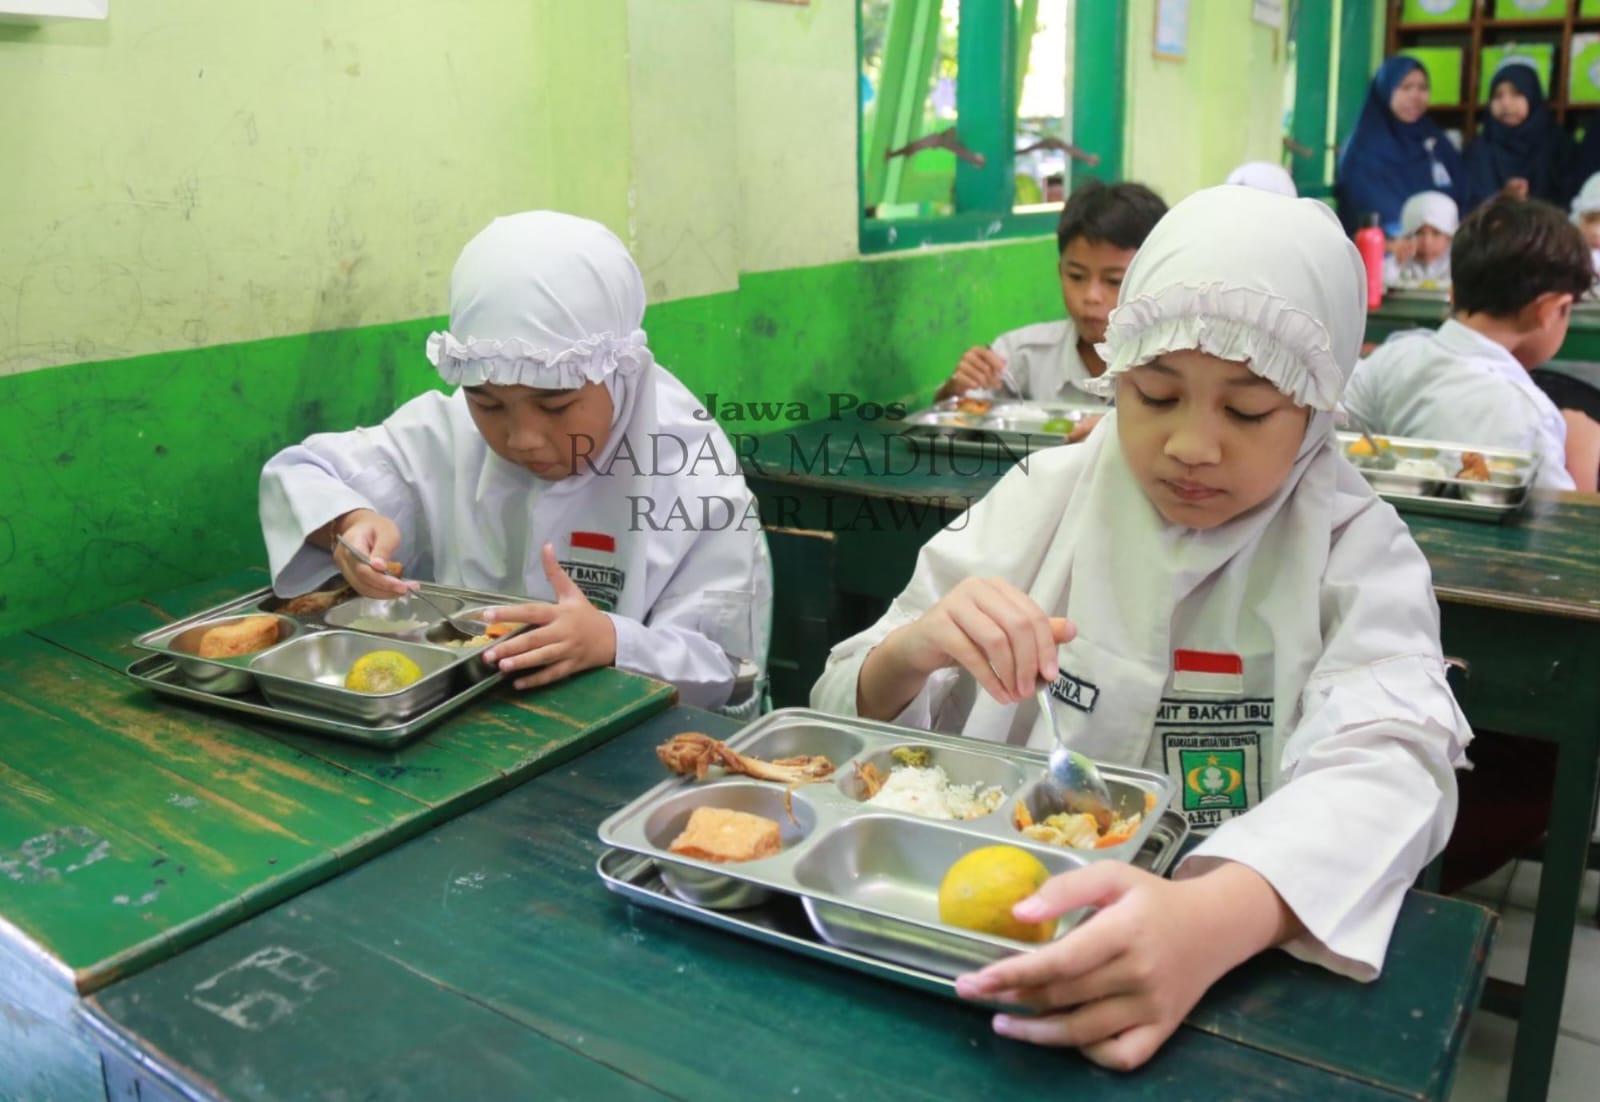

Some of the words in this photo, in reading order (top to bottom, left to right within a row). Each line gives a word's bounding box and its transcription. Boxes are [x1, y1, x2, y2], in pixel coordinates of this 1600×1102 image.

[576, 567, 608, 583] BAKTI
[1188, 705, 1237, 720] BAKTI
[1244, 705, 1270, 719] IBU
[1184, 810, 1222, 824] AKTI
